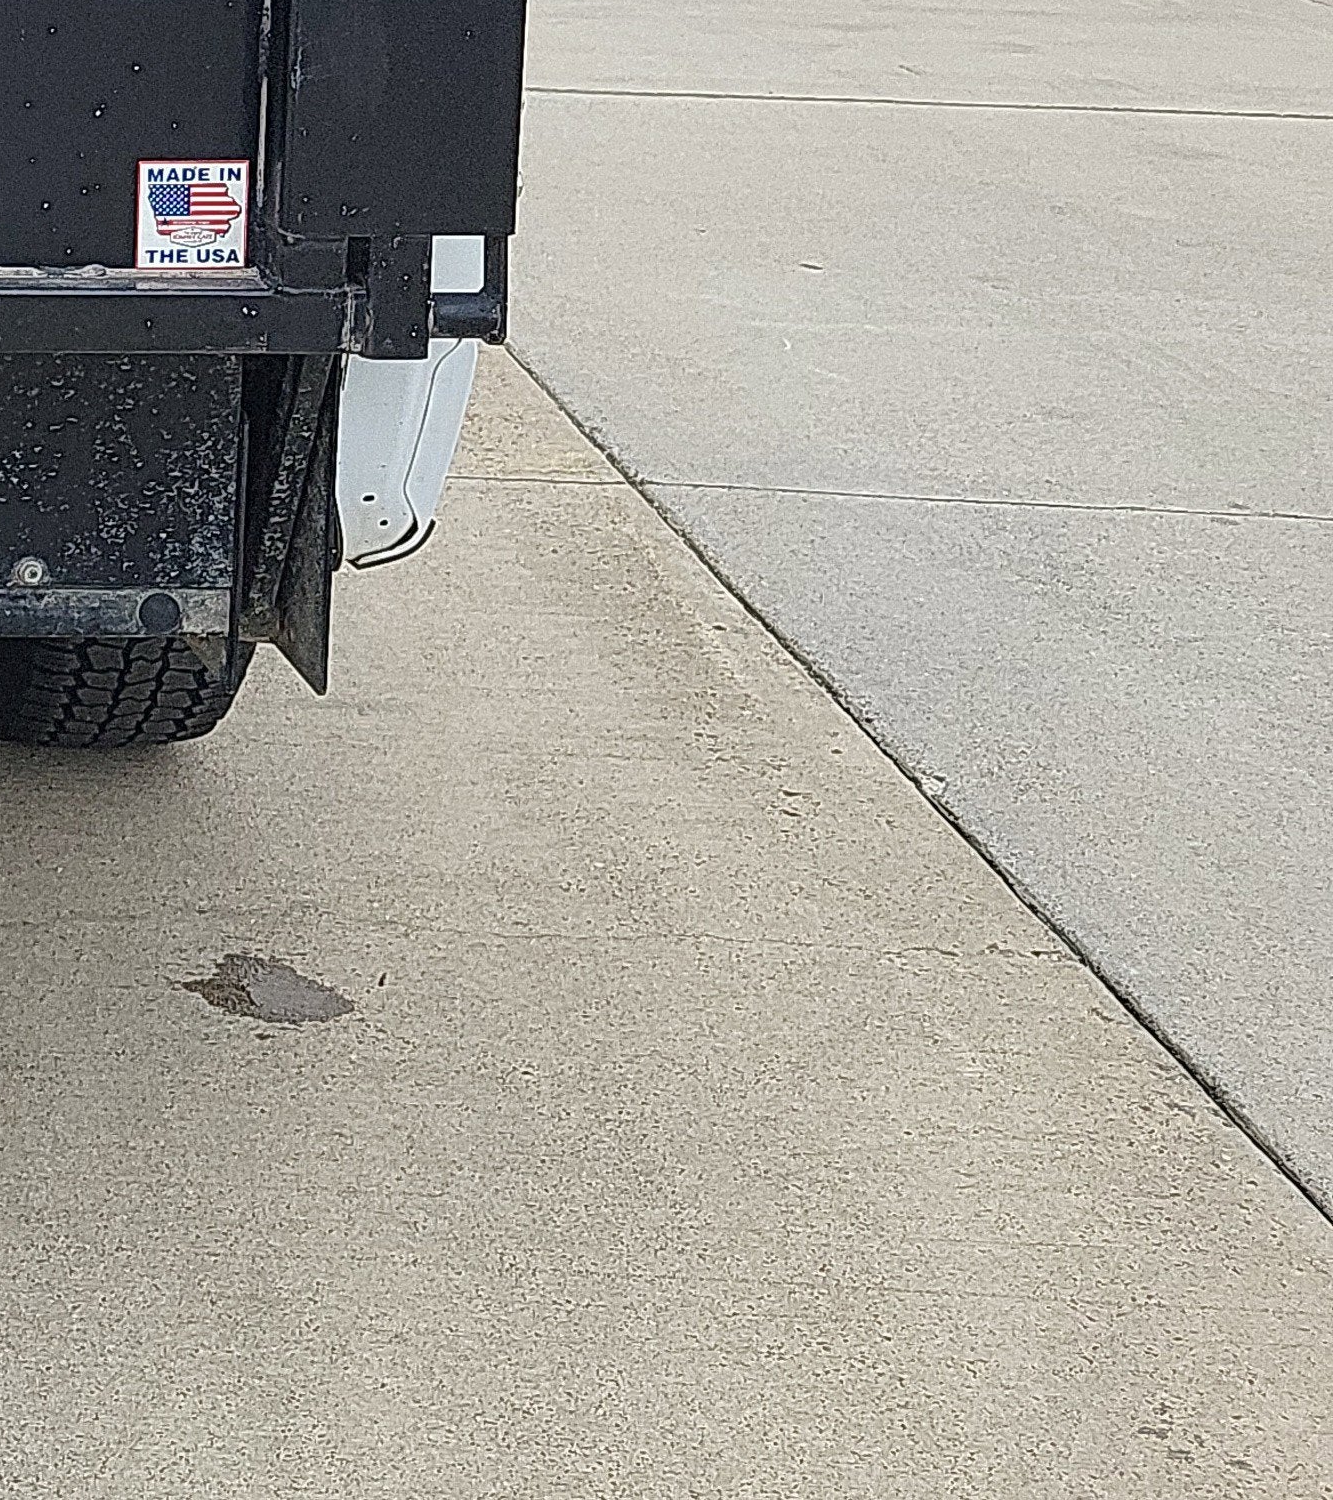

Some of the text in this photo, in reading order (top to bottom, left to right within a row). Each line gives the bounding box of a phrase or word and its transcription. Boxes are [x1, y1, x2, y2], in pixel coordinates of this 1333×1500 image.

[147, 167, 241, 182] MADE IN
[145, 250, 239, 263] THE USA
